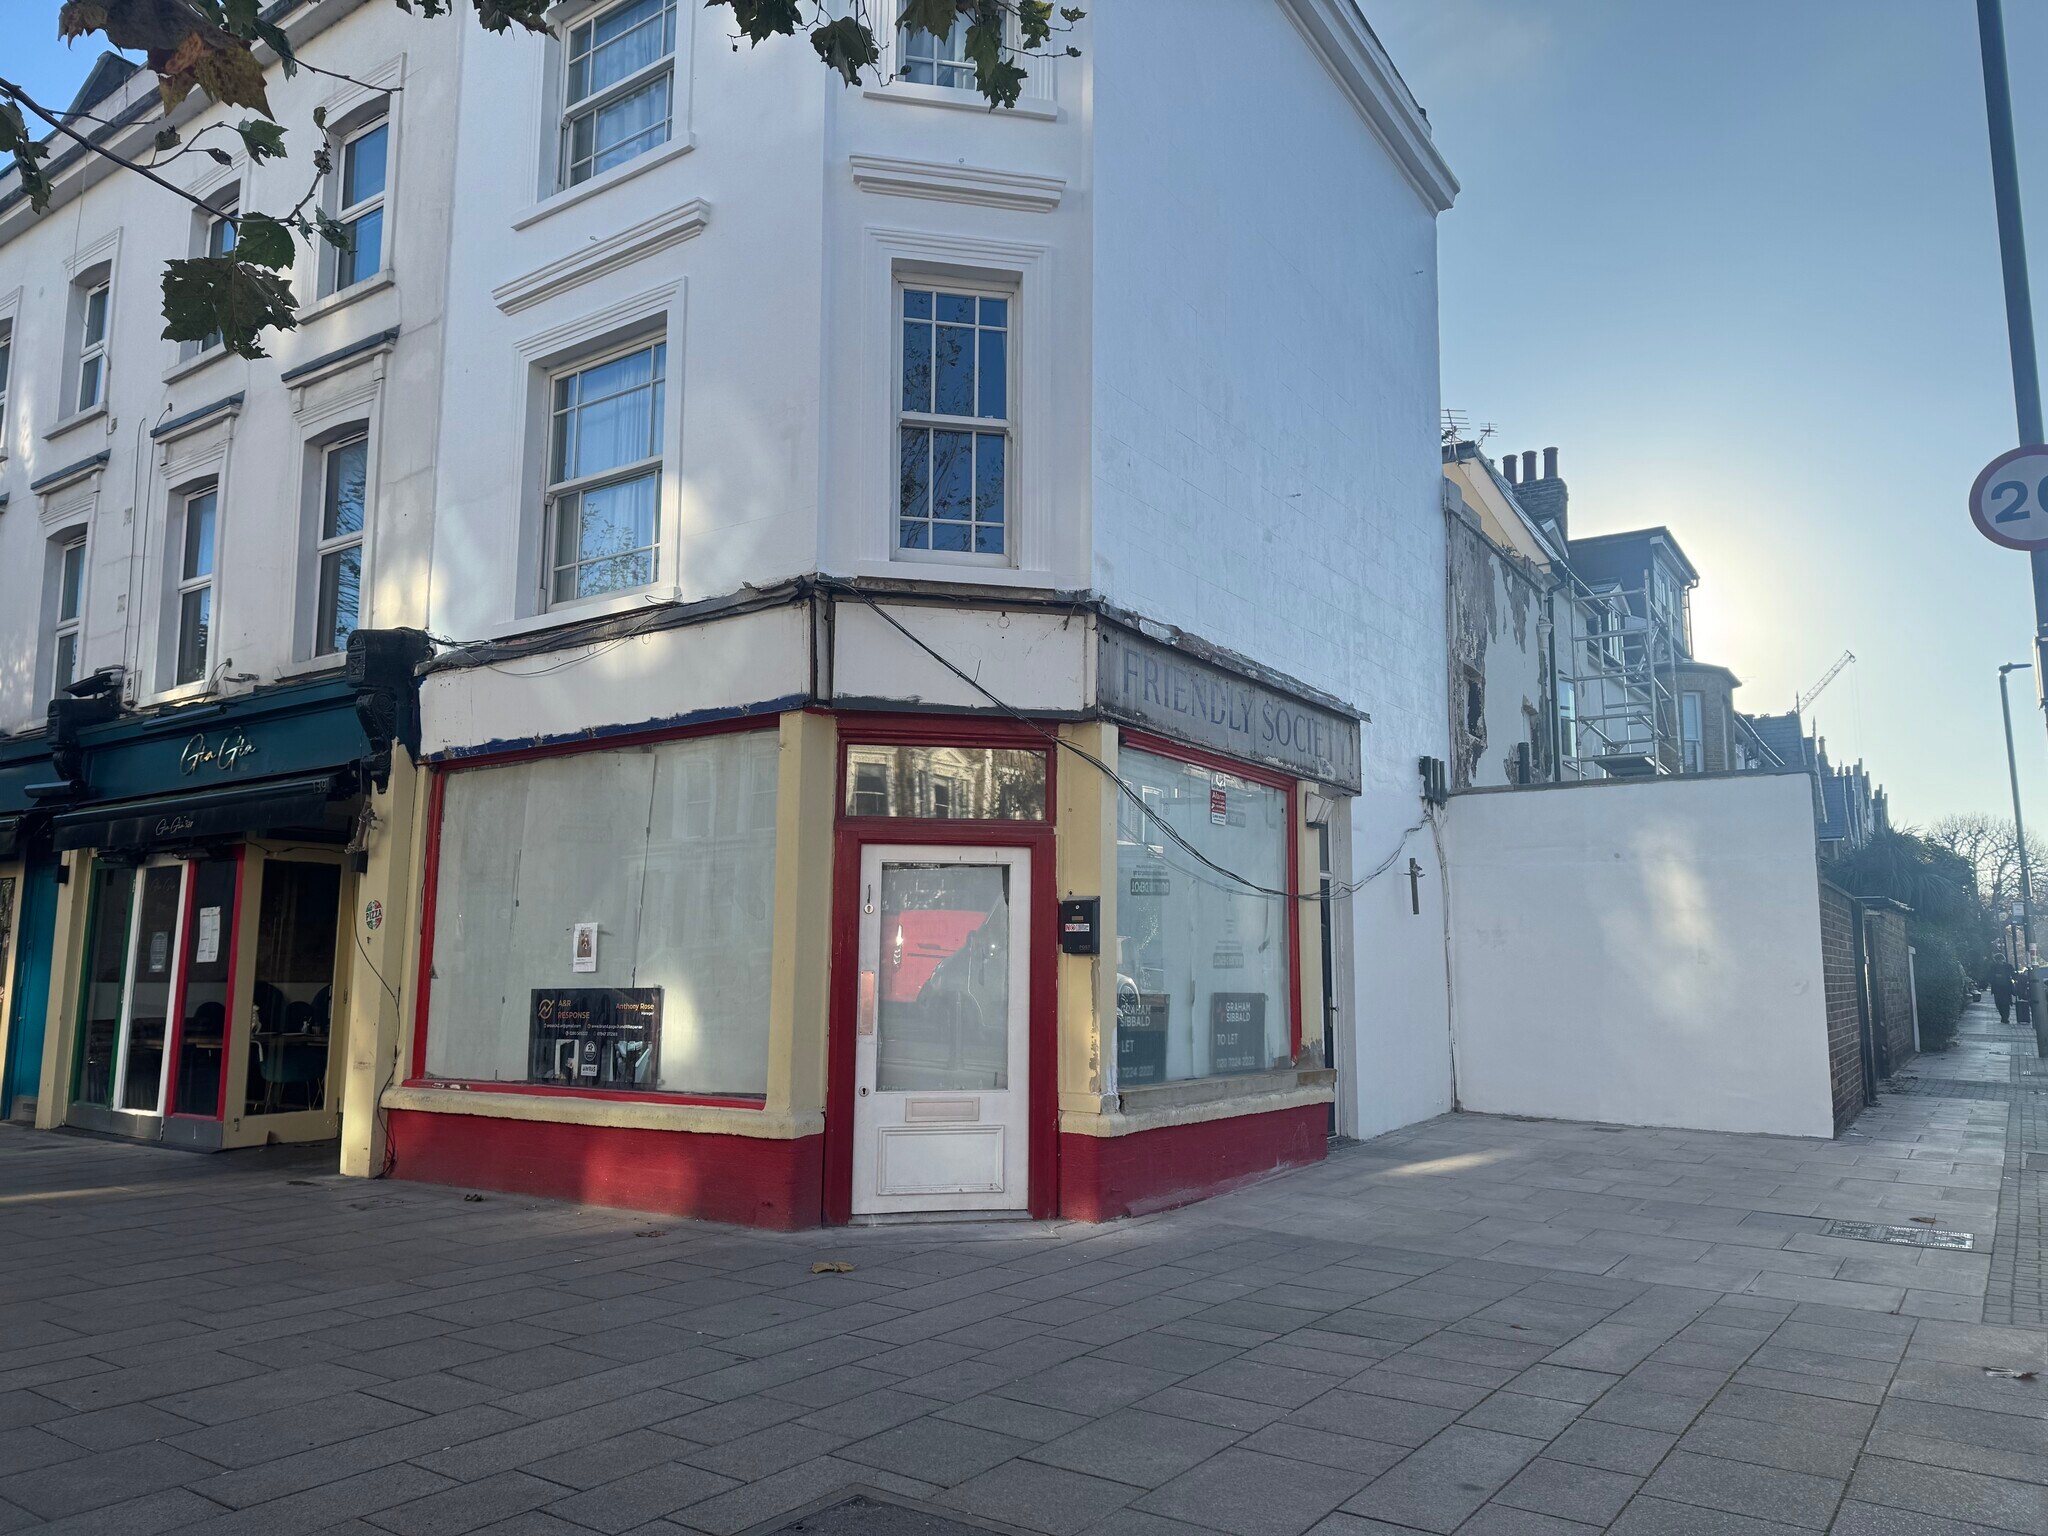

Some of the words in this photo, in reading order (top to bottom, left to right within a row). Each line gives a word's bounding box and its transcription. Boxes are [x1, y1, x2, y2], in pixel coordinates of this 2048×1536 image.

[1123, 647, 1254, 734] FRIENDLY
[1262, 700, 1350, 767] SOCIETY
[365, 908, 383, 921] PIZZA
[615, 1003, 639, 1011] Anthony
[640, 1002, 655, 1010] Rose
[1225, 1002, 1251, 1012] GRAHAM
[558, 1011, 590, 1019] RESPONSE
[1226, 1012, 1251, 1022] SIBBALD
[1120, 1016, 1151, 1027] SIBBALD
[1217, 1034, 1226, 1046] TO
[1227, 1033, 1239, 1045] LET
[1121, 1040, 1135, 1053] LET
